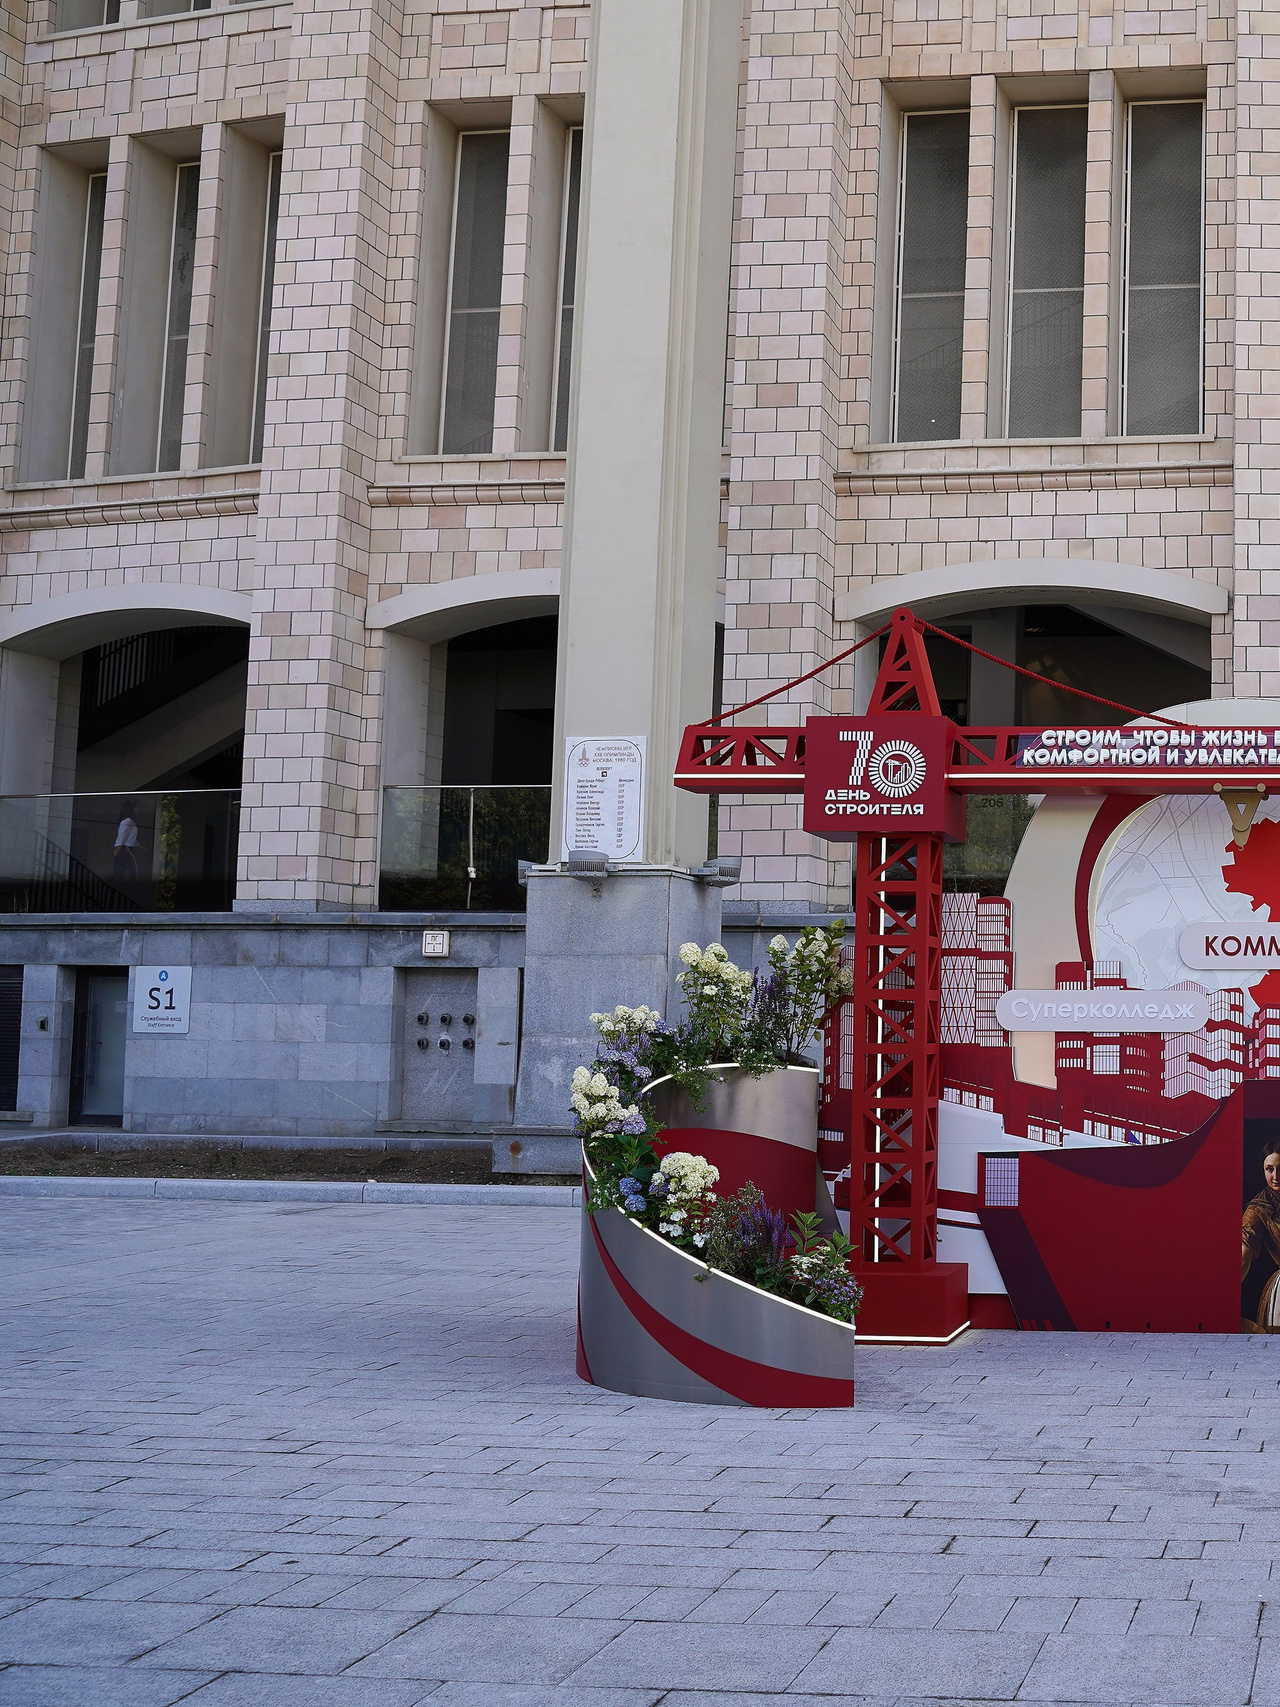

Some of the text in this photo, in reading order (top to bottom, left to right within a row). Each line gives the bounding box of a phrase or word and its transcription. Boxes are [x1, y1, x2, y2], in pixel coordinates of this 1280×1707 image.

[1041, 729, 1127, 747] СТРОИМ,
[1133, 729, 1196, 747] ЧТОБЫ
[1201, 730, 1268, 747] ЖИЗНЬ
[1022, 746, 1160, 766] КОМФОРТНОЙ
[1166, 748, 1179, 766] И
[824, 789, 871, 800] ДЕНЬ
[824, 803, 924, 815] СТРОИТЕЛЯ
[147, 987, 176, 1010] S1
[1010, 998, 1195, 1023] Суперколледж
